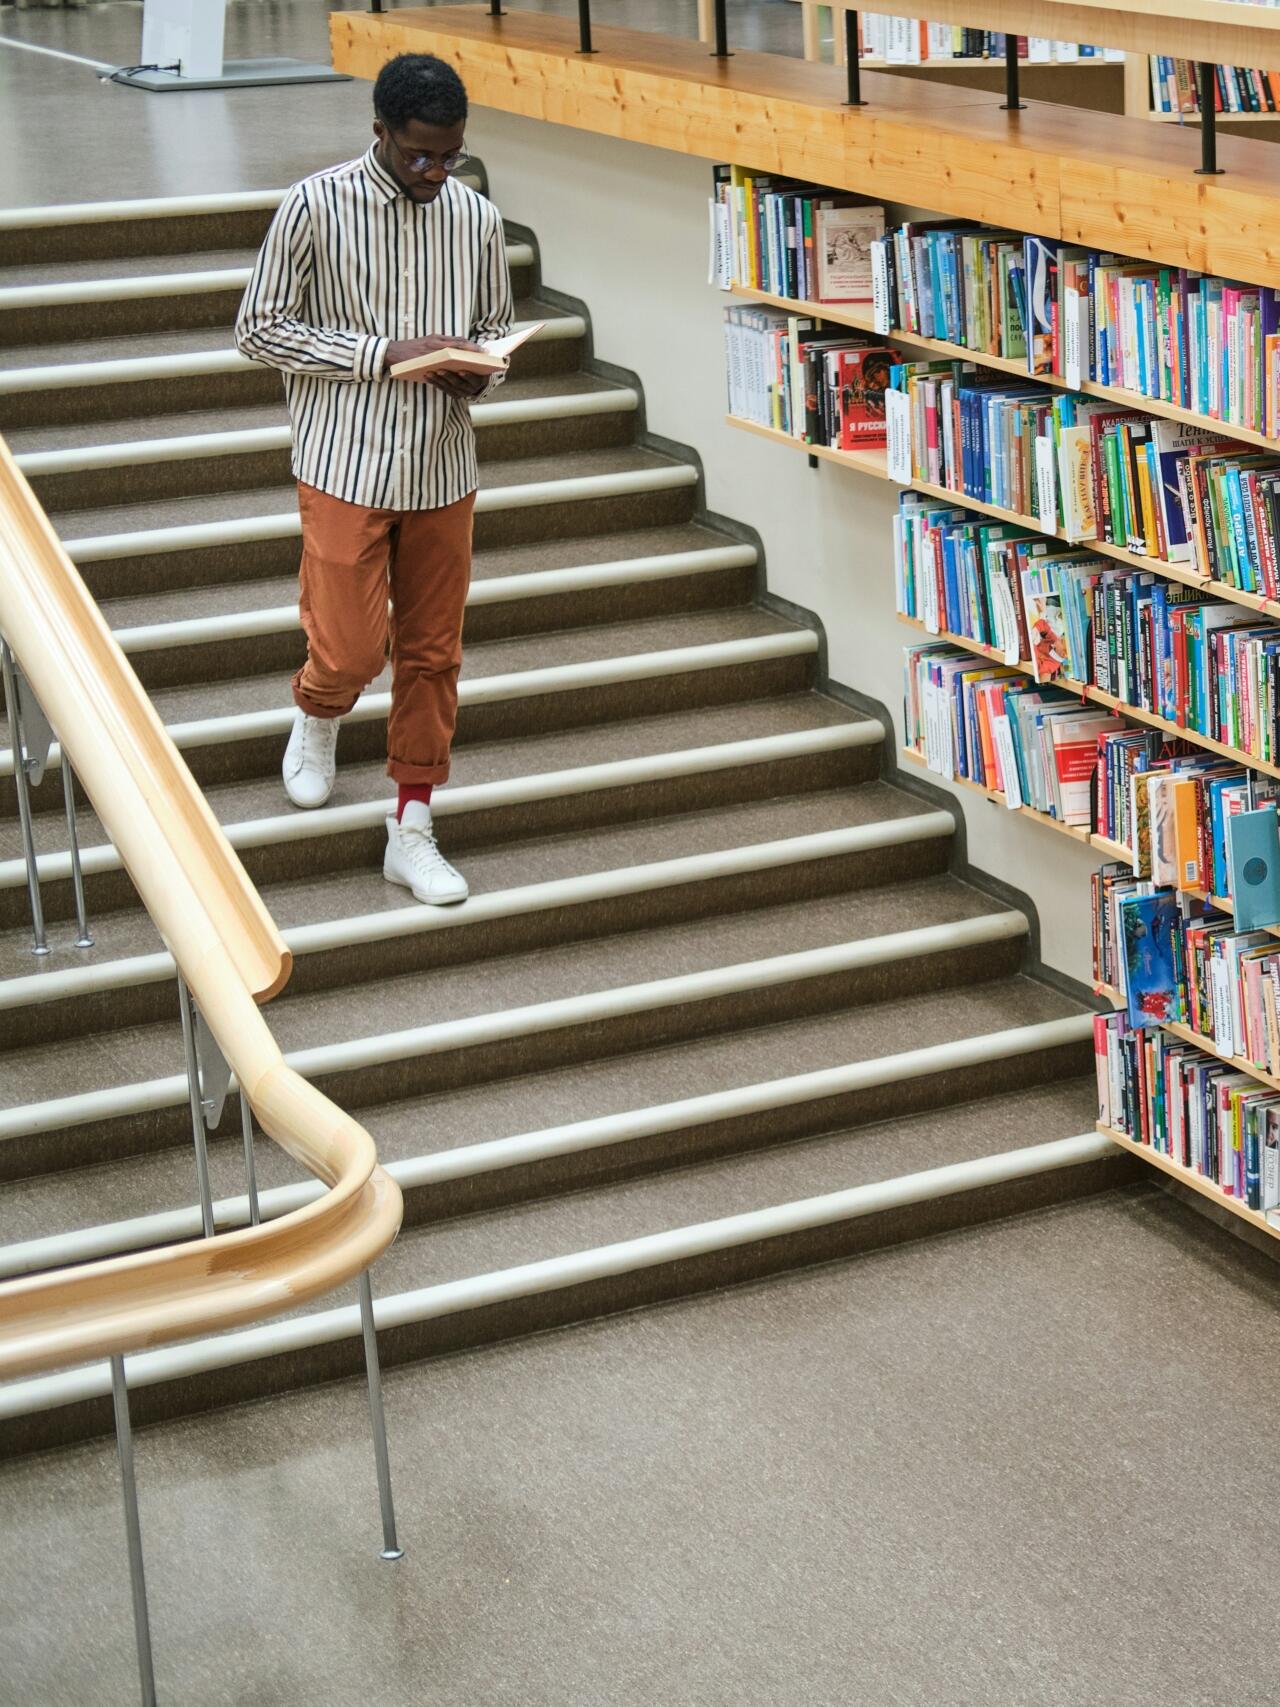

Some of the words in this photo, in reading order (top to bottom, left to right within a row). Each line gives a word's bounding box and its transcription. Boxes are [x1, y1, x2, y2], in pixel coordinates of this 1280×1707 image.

[1183, 464, 1192, 492] самбо
[1188, 502, 1197, 518] Все
[1202, 498, 1212, 527] Кройфф
[1206, 528, 1214, 549] Йохан
[1232, 513, 1245, 556] АГУЭРО
[1258, 506, 1271, 558] МАКГРЕГОР
[1268, 536, 1279, 572] MANAGER
[1272, 574, 1280, 598] THE
[1114, 619, 1122, 658] ДЖОРДАН
